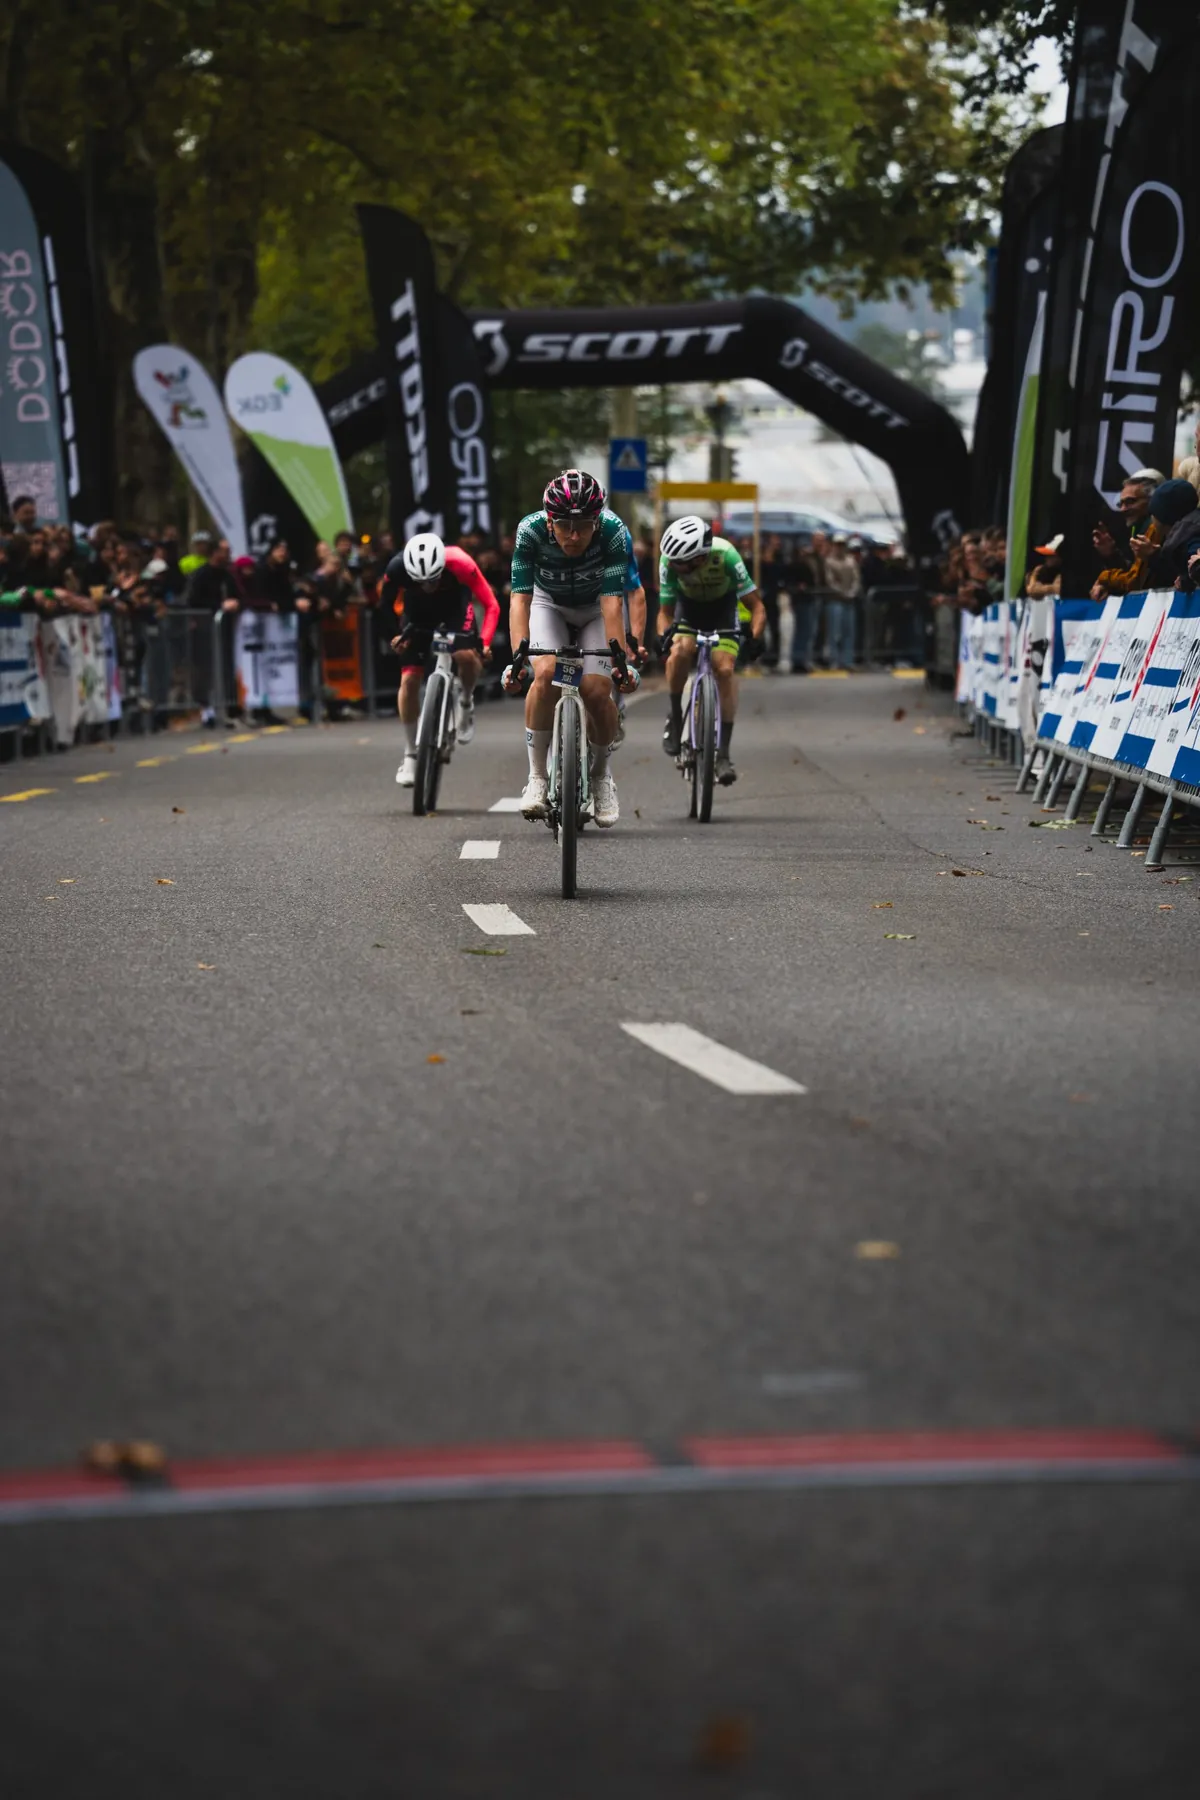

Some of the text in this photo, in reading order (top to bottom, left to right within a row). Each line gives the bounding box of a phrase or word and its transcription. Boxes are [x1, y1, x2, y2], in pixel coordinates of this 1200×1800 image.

[517, 323, 743, 362] SCOTT
[1094, 181, 1184, 512] GIRO
[803, 361, 910, 428] SCOTT
[540, 566, 605, 582] BIXS
[562, 665, 576, 675] 56
